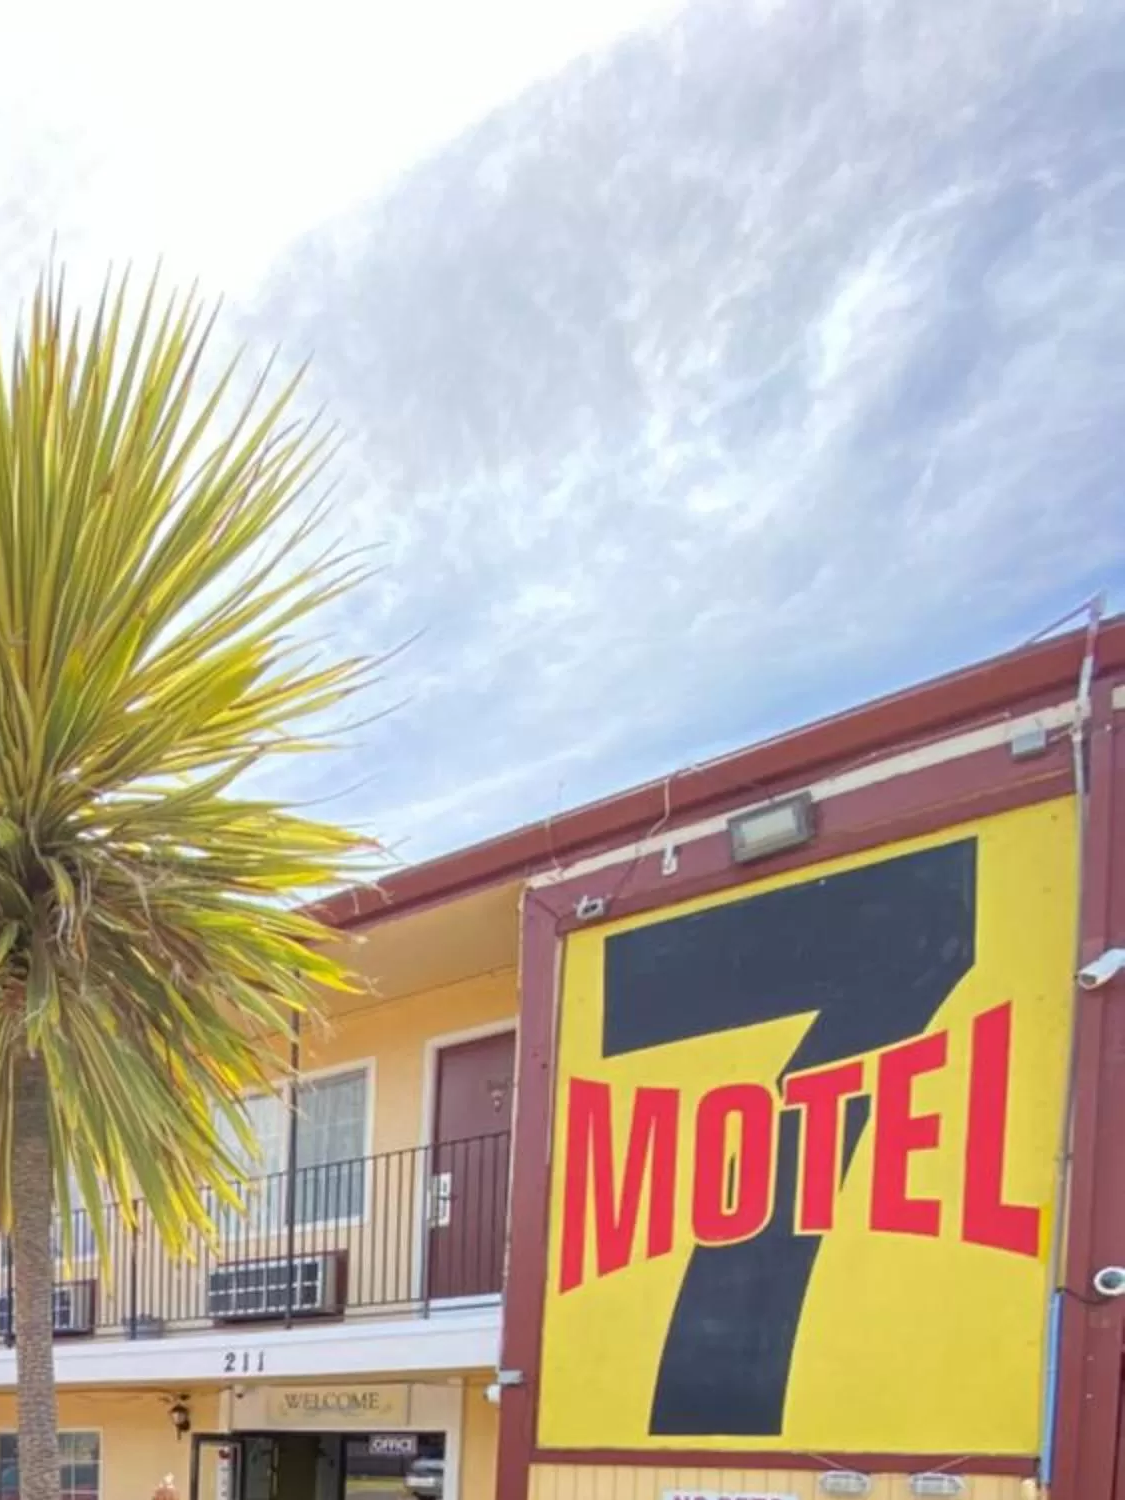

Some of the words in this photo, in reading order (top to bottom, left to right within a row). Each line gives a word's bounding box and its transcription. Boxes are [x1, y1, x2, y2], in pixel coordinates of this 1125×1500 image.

[558, 1000, 1041, 1296] MOTEL
[602, 835, 979, 1437] 7
[224, 1351, 265, 1372] 211
[283, 1391, 380, 1410] WELCOME
